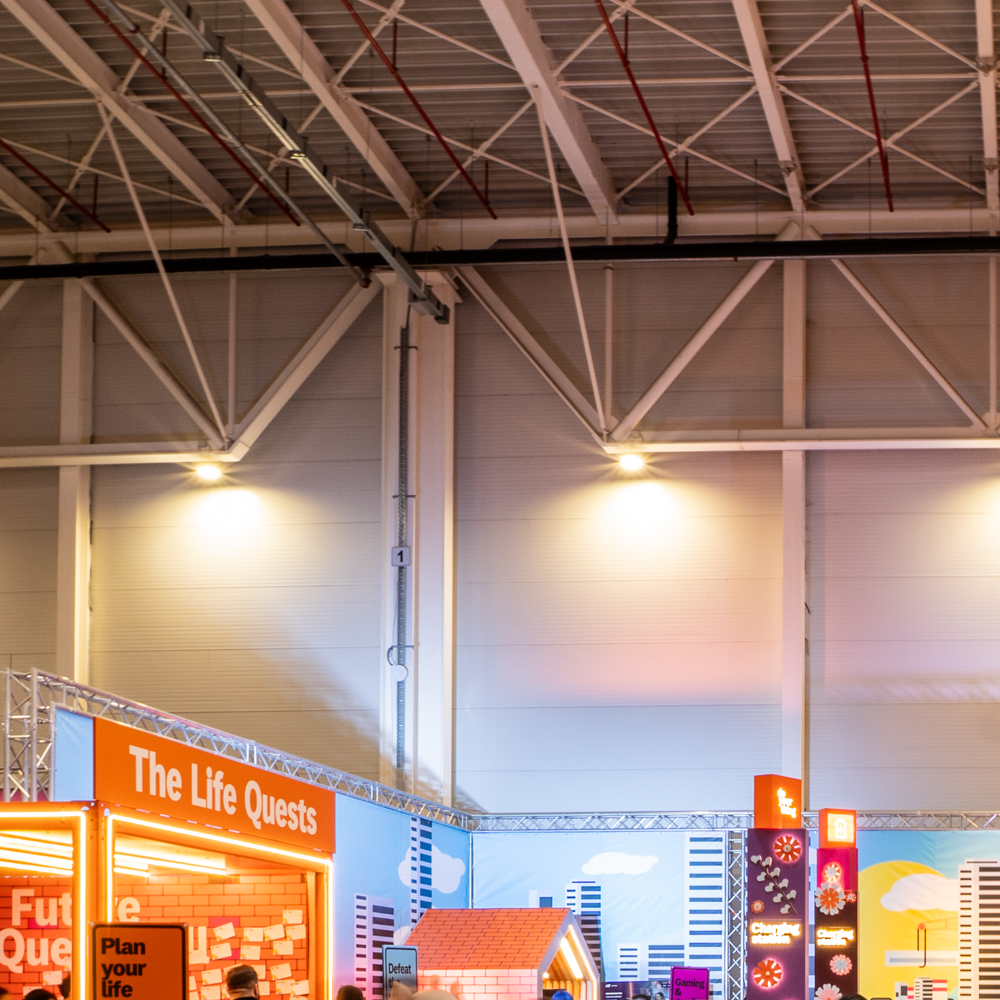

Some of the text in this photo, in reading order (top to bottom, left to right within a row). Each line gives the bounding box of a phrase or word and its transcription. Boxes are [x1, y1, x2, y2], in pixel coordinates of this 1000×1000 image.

[397, 550, 404, 563] 1
[129, 745, 318, 835] The Life Quests
[12, 888, 140, 927] Fute
[101, 937, 146, 955] Plan
[101, 963, 147, 980] your
[388, 963, 412, 975] Defeat
[101, 980, 133, 998] life
[675, 978, 705, 989] Gaming
[675, 988, 682, 996] &
